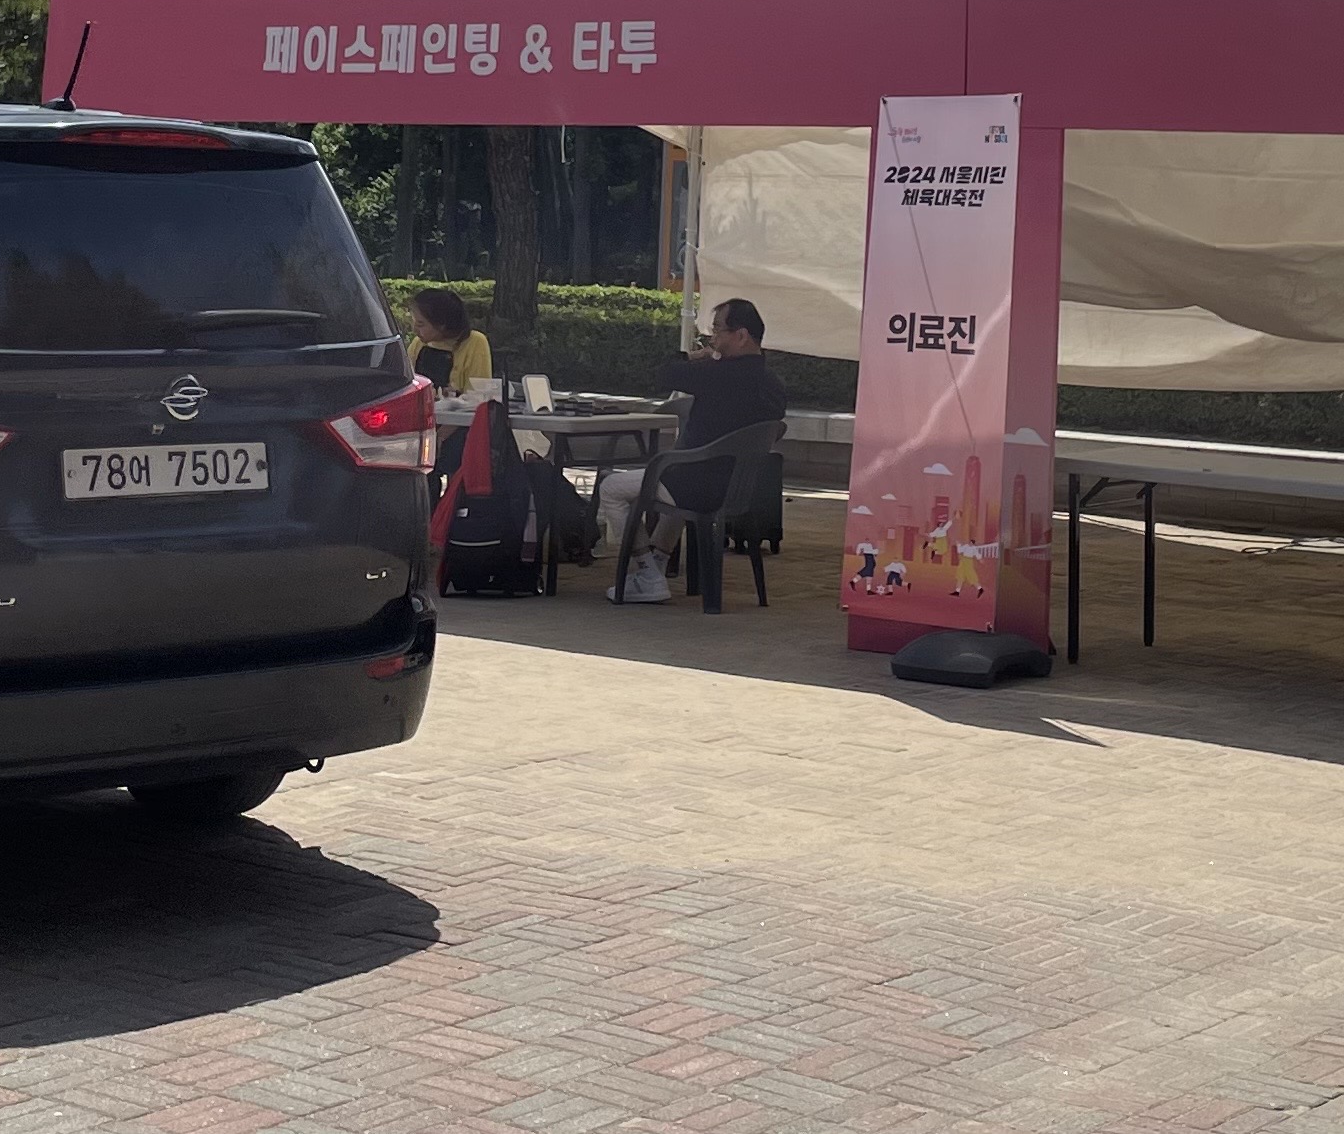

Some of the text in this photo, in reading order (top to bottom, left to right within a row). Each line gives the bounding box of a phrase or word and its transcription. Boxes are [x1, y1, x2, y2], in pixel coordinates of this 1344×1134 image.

[263, 21, 657, 76] 페이스페인팅 & 타투
[884, 166, 1007, 185] 2024 서울시민
[901, 188, 985, 207] 체육대축전
[887, 312, 976, 355] 의료진
[82, 448, 251, 492] 78어 7502
